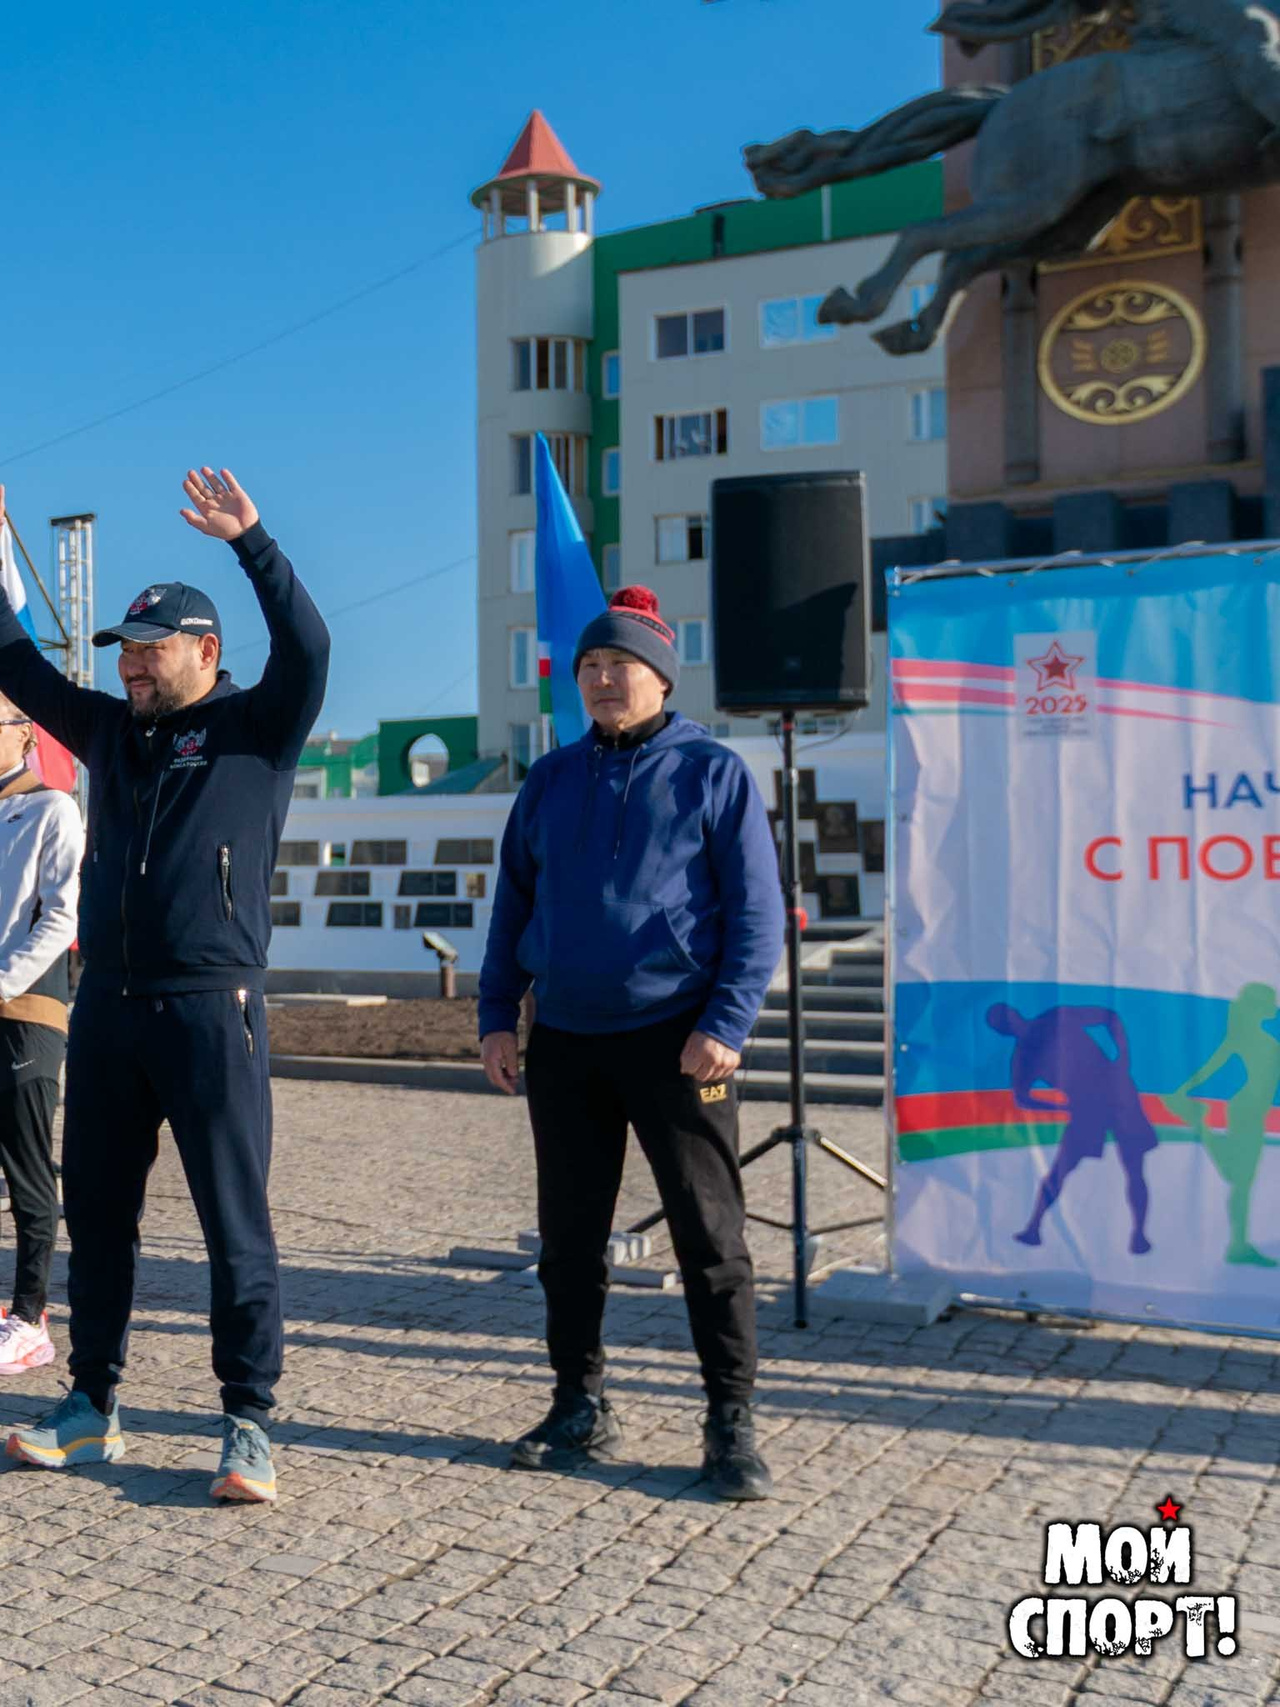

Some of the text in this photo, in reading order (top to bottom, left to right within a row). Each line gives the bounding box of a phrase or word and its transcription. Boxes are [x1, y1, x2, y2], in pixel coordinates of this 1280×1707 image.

[1025, 694, 1087, 716] 2025
[1084, 836, 1124, 882] С
[700, 1083, 727, 1103] EA7
